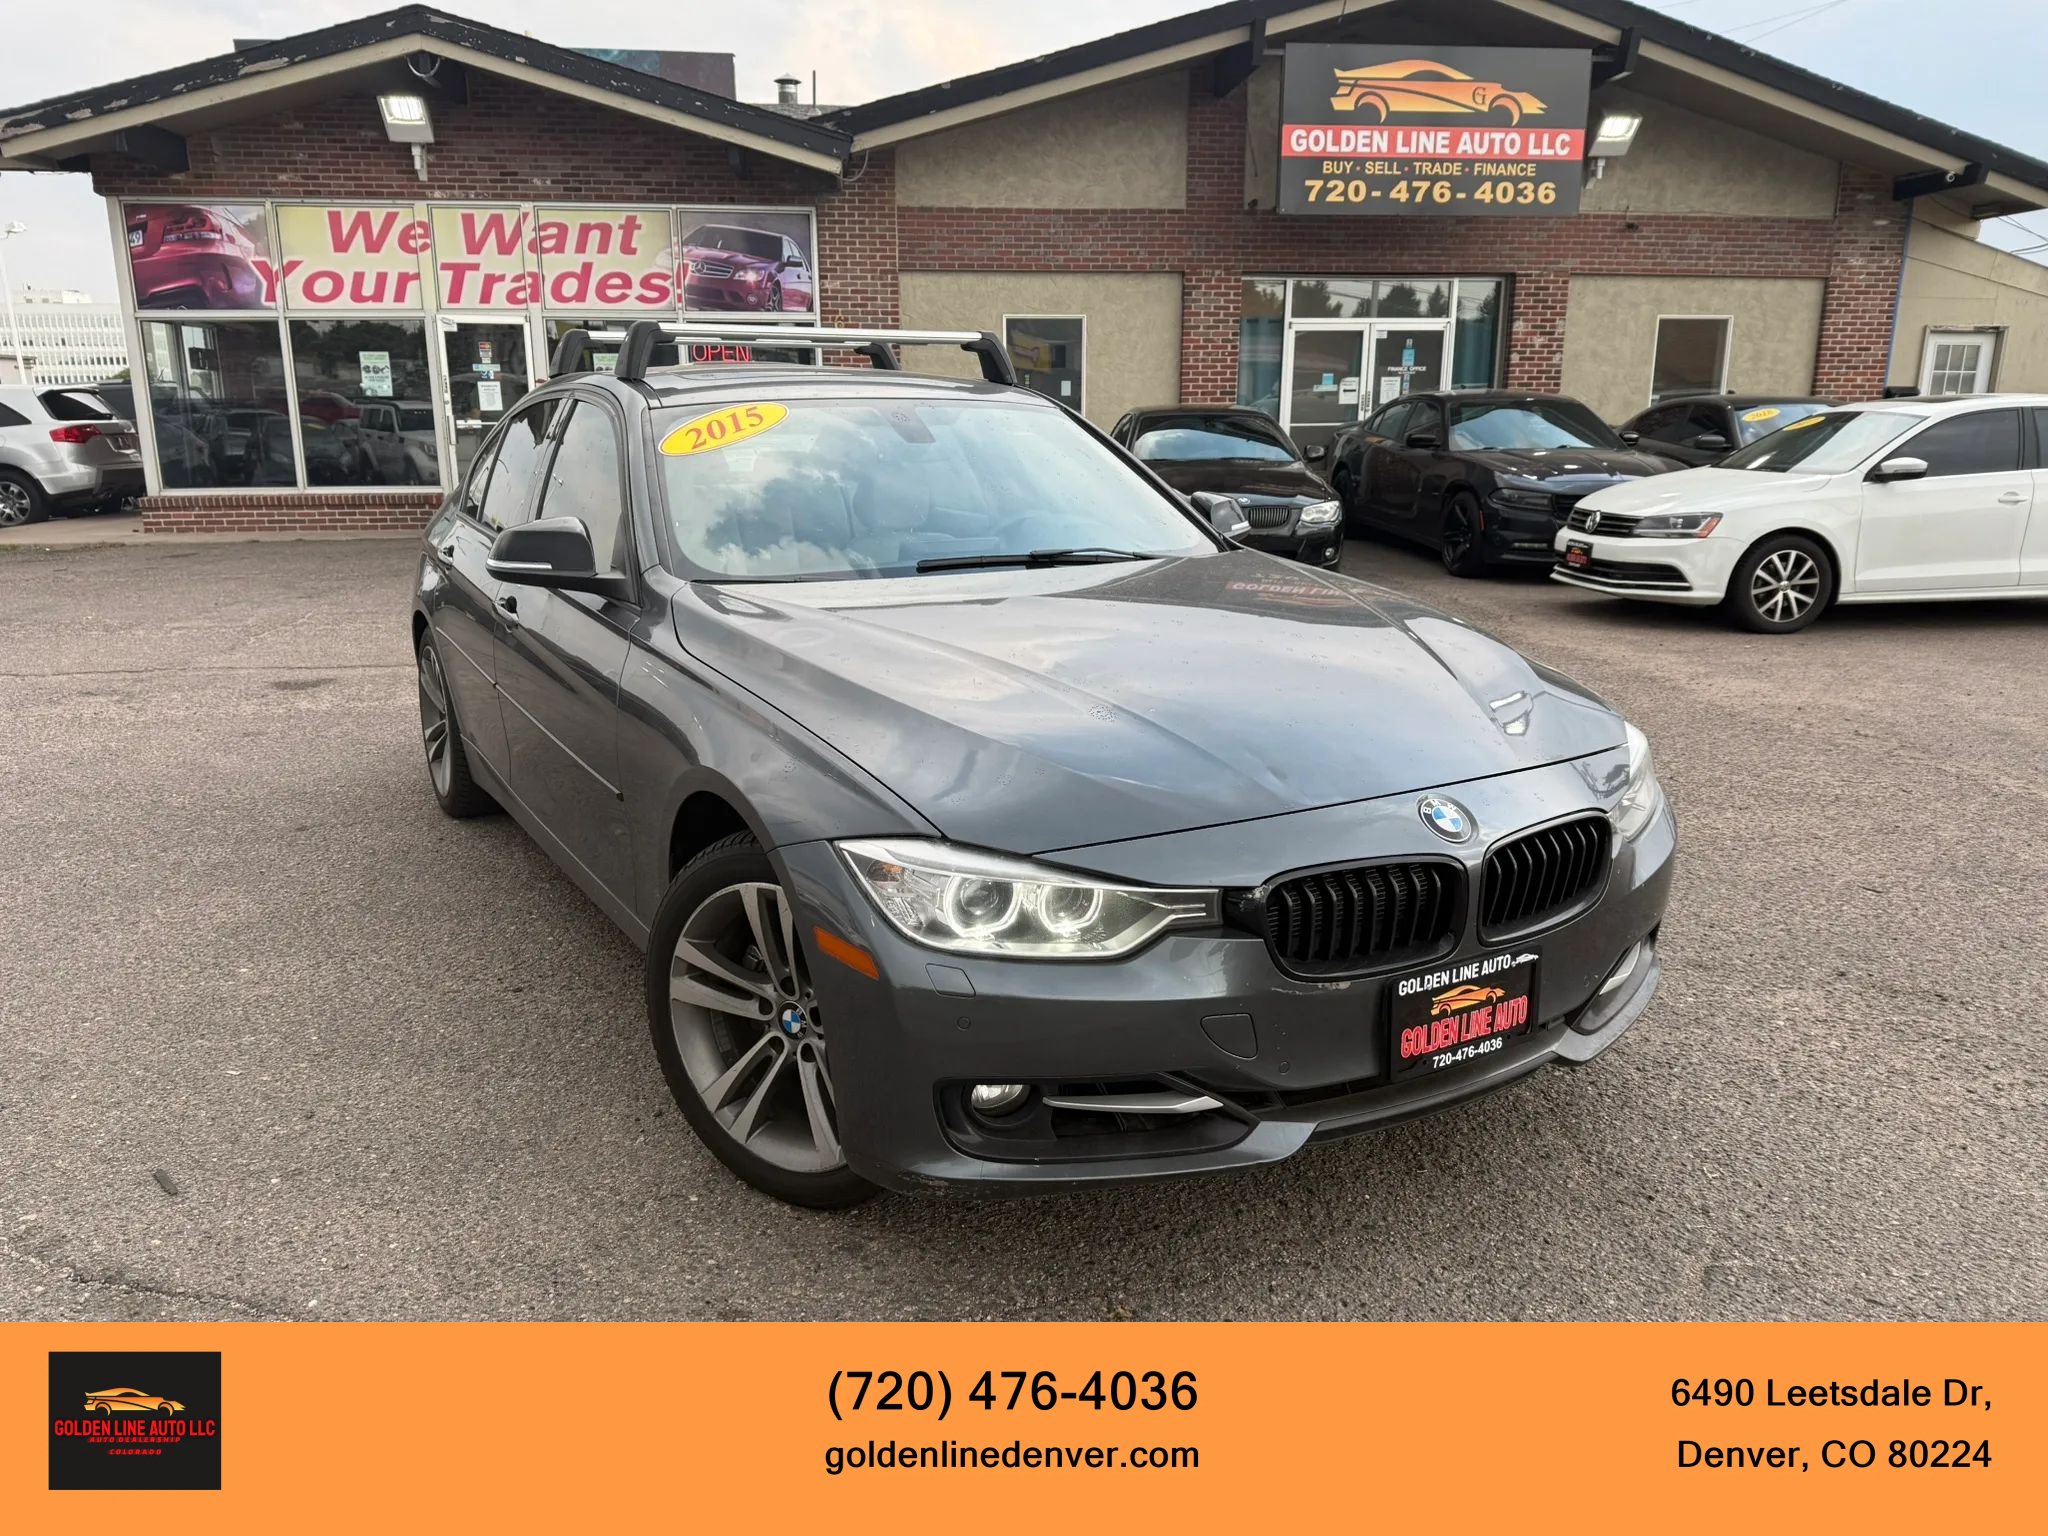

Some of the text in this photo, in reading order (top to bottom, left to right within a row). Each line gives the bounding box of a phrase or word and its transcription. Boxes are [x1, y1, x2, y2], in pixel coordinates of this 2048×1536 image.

[1290, 128, 1571, 156] GOLDEN LINE AUTO LLC
[1322, 160, 1536, 177] BUY SELL TRADE FINANCE
[328, 208, 643, 257] We Want
[251, 259, 690, 307] Your Trades!
[692, 344, 752, 362] OPEN
[685, 406, 765, 450] 2015
[1398, 954, 1511, 997] GOLDEN LINE AUTO
[1400, 995, 1528, 1059] GOLDEN LINE AUTO
[1432, 1036, 1503, 1069] 720-476-4036
